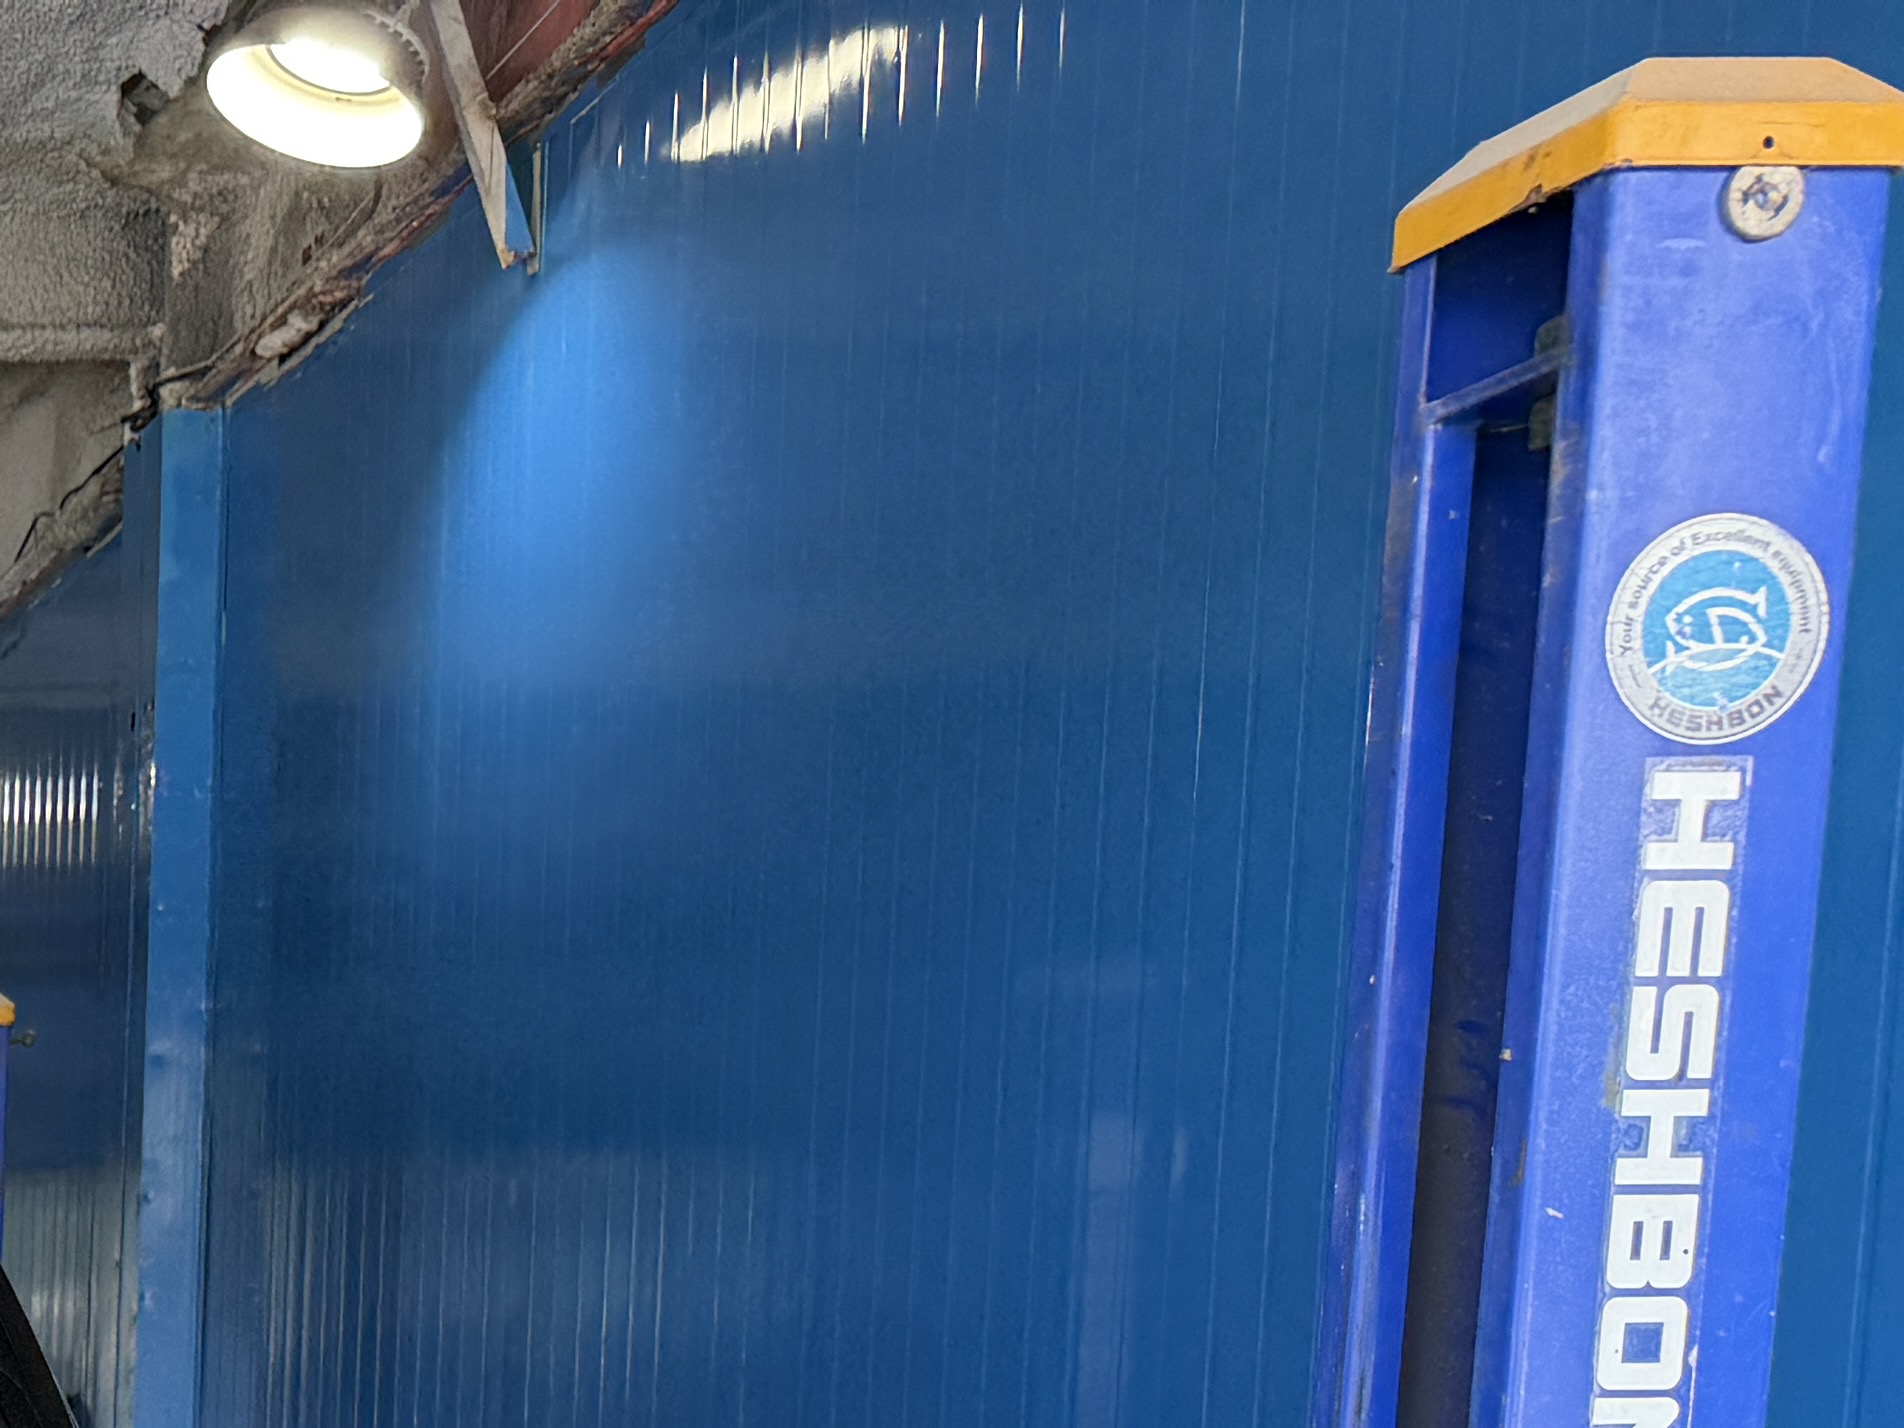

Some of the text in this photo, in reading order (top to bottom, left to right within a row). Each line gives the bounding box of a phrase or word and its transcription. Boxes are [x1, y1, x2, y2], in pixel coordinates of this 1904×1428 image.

[1617, 612, 1635, 657] Your
[1627, 555, 1670, 612] source
[1669, 537, 1691, 559] of
[1690, 528, 1772, 553] Excellent
[1647, 683, 1785, 733] HESHBON
